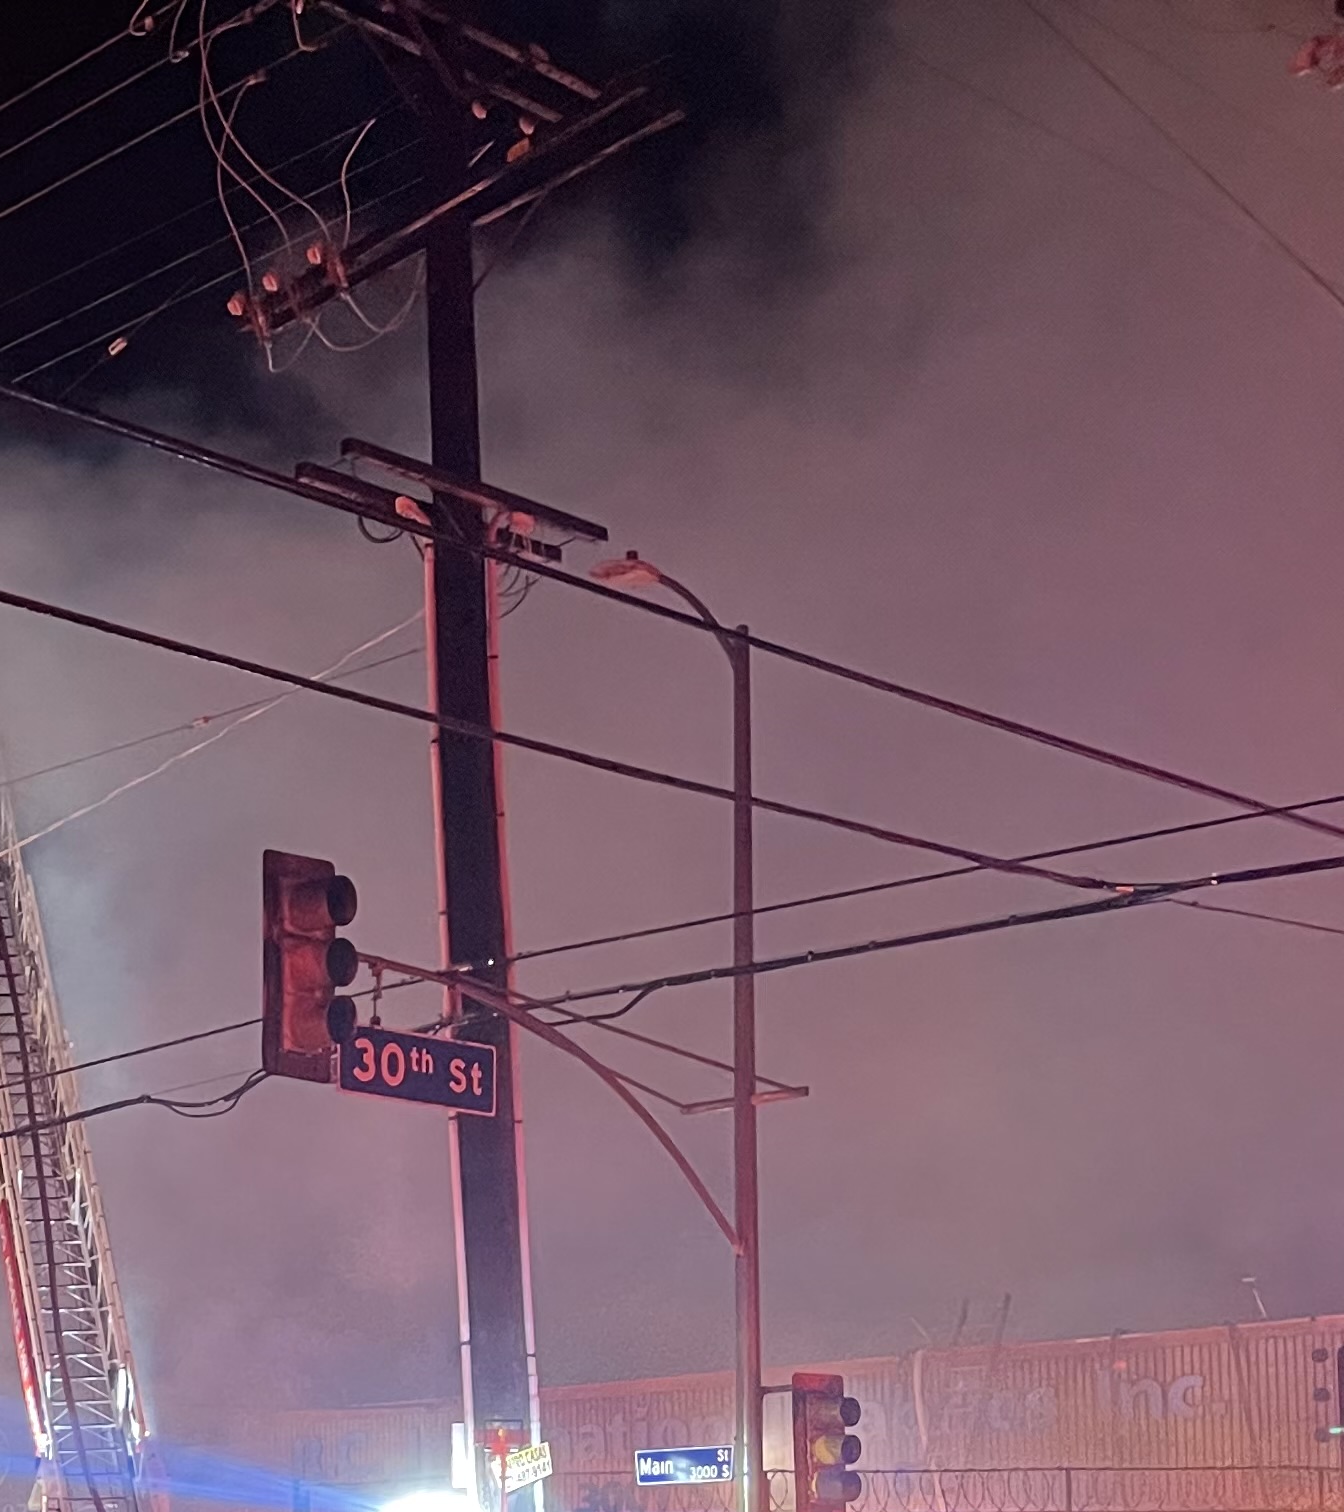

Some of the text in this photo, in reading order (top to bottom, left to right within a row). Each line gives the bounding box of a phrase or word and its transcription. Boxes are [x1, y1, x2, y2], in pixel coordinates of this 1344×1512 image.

[353, 1037, 483, 1096] 30th St
[639, 1449, 729, 1476] Main St
[689, 1463, 731, 1480] 3000 S
